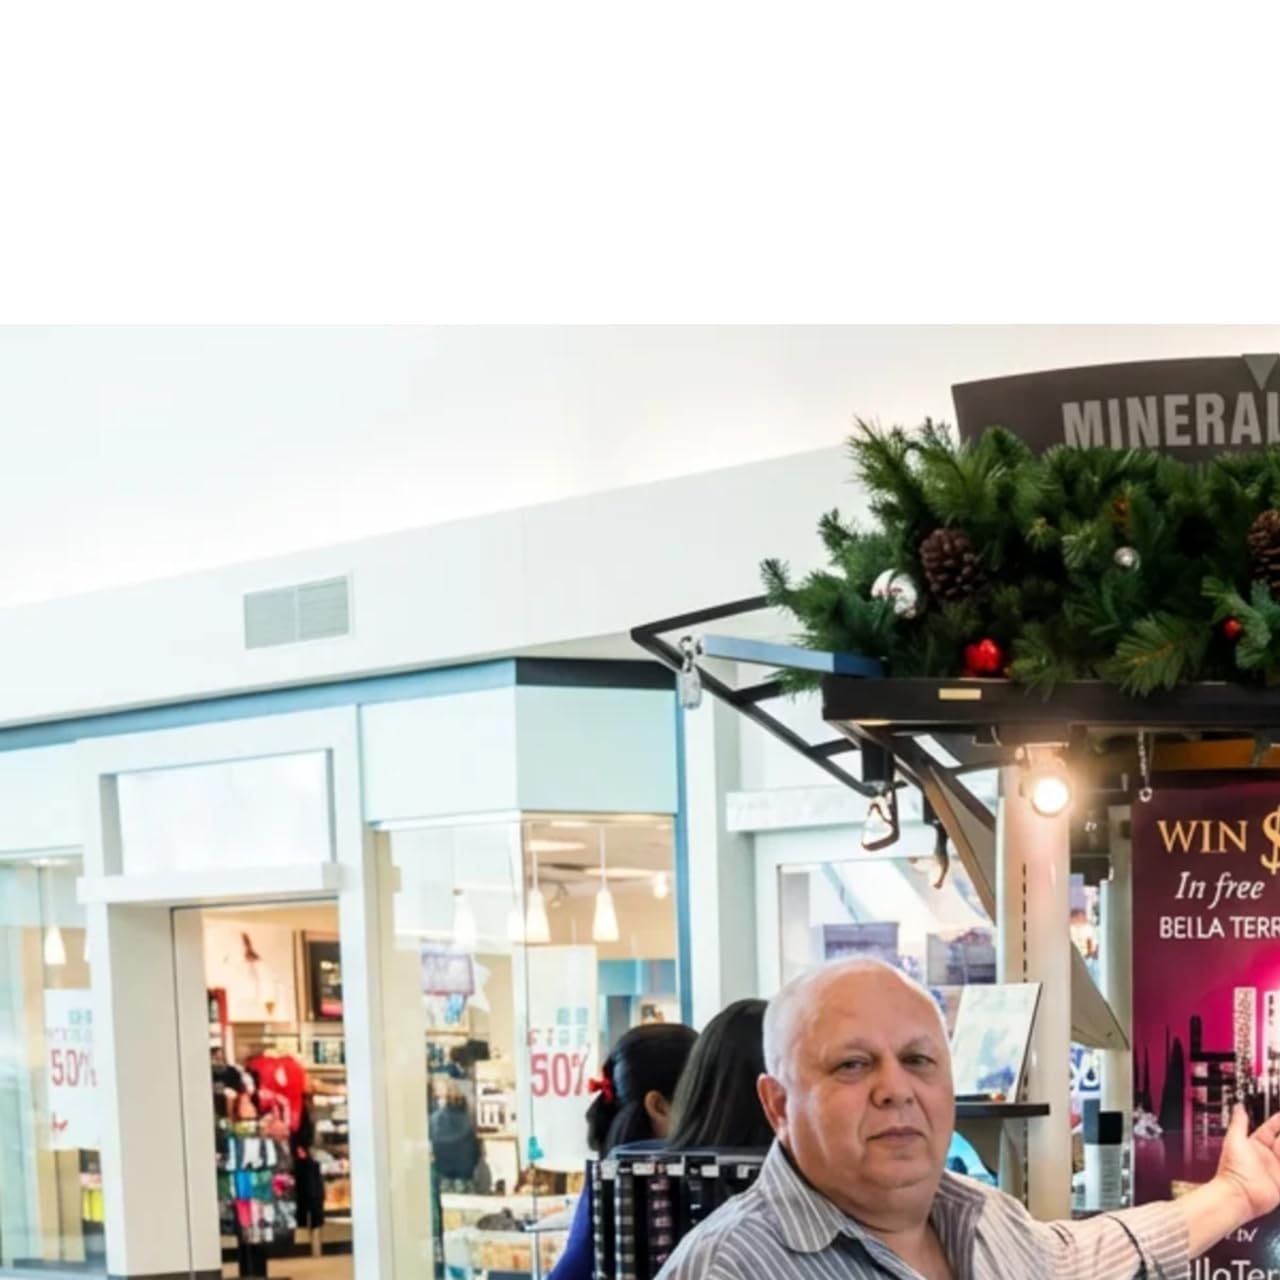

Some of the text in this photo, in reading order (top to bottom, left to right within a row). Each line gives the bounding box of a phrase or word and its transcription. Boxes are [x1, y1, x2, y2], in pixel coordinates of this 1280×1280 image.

[1157, 820, 1248, 853] WIN
[1175, 872, 1265, 909] In free
[1159, 917, 1225, 939] BELLA
